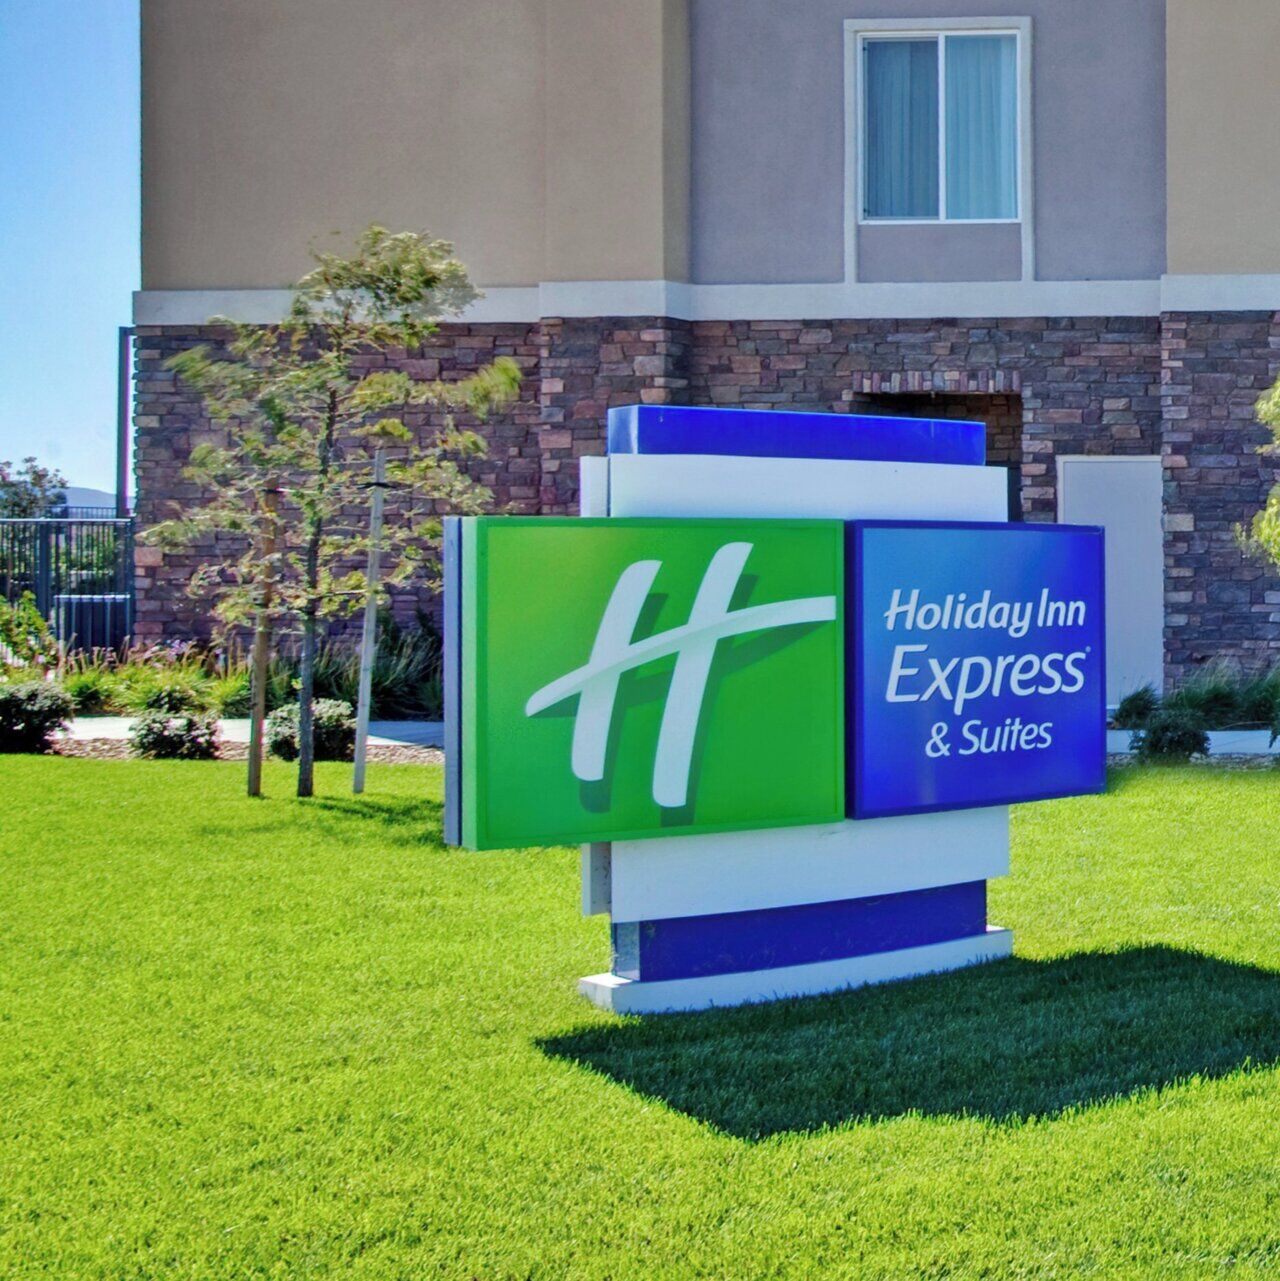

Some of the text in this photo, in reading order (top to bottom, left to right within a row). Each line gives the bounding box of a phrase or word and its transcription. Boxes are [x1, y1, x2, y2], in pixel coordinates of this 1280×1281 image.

[884, 588, 1086, 638] Holiday Inn
[886, 644, 1087, 716] Express
[925, 717, 1053, 758] & Suites
